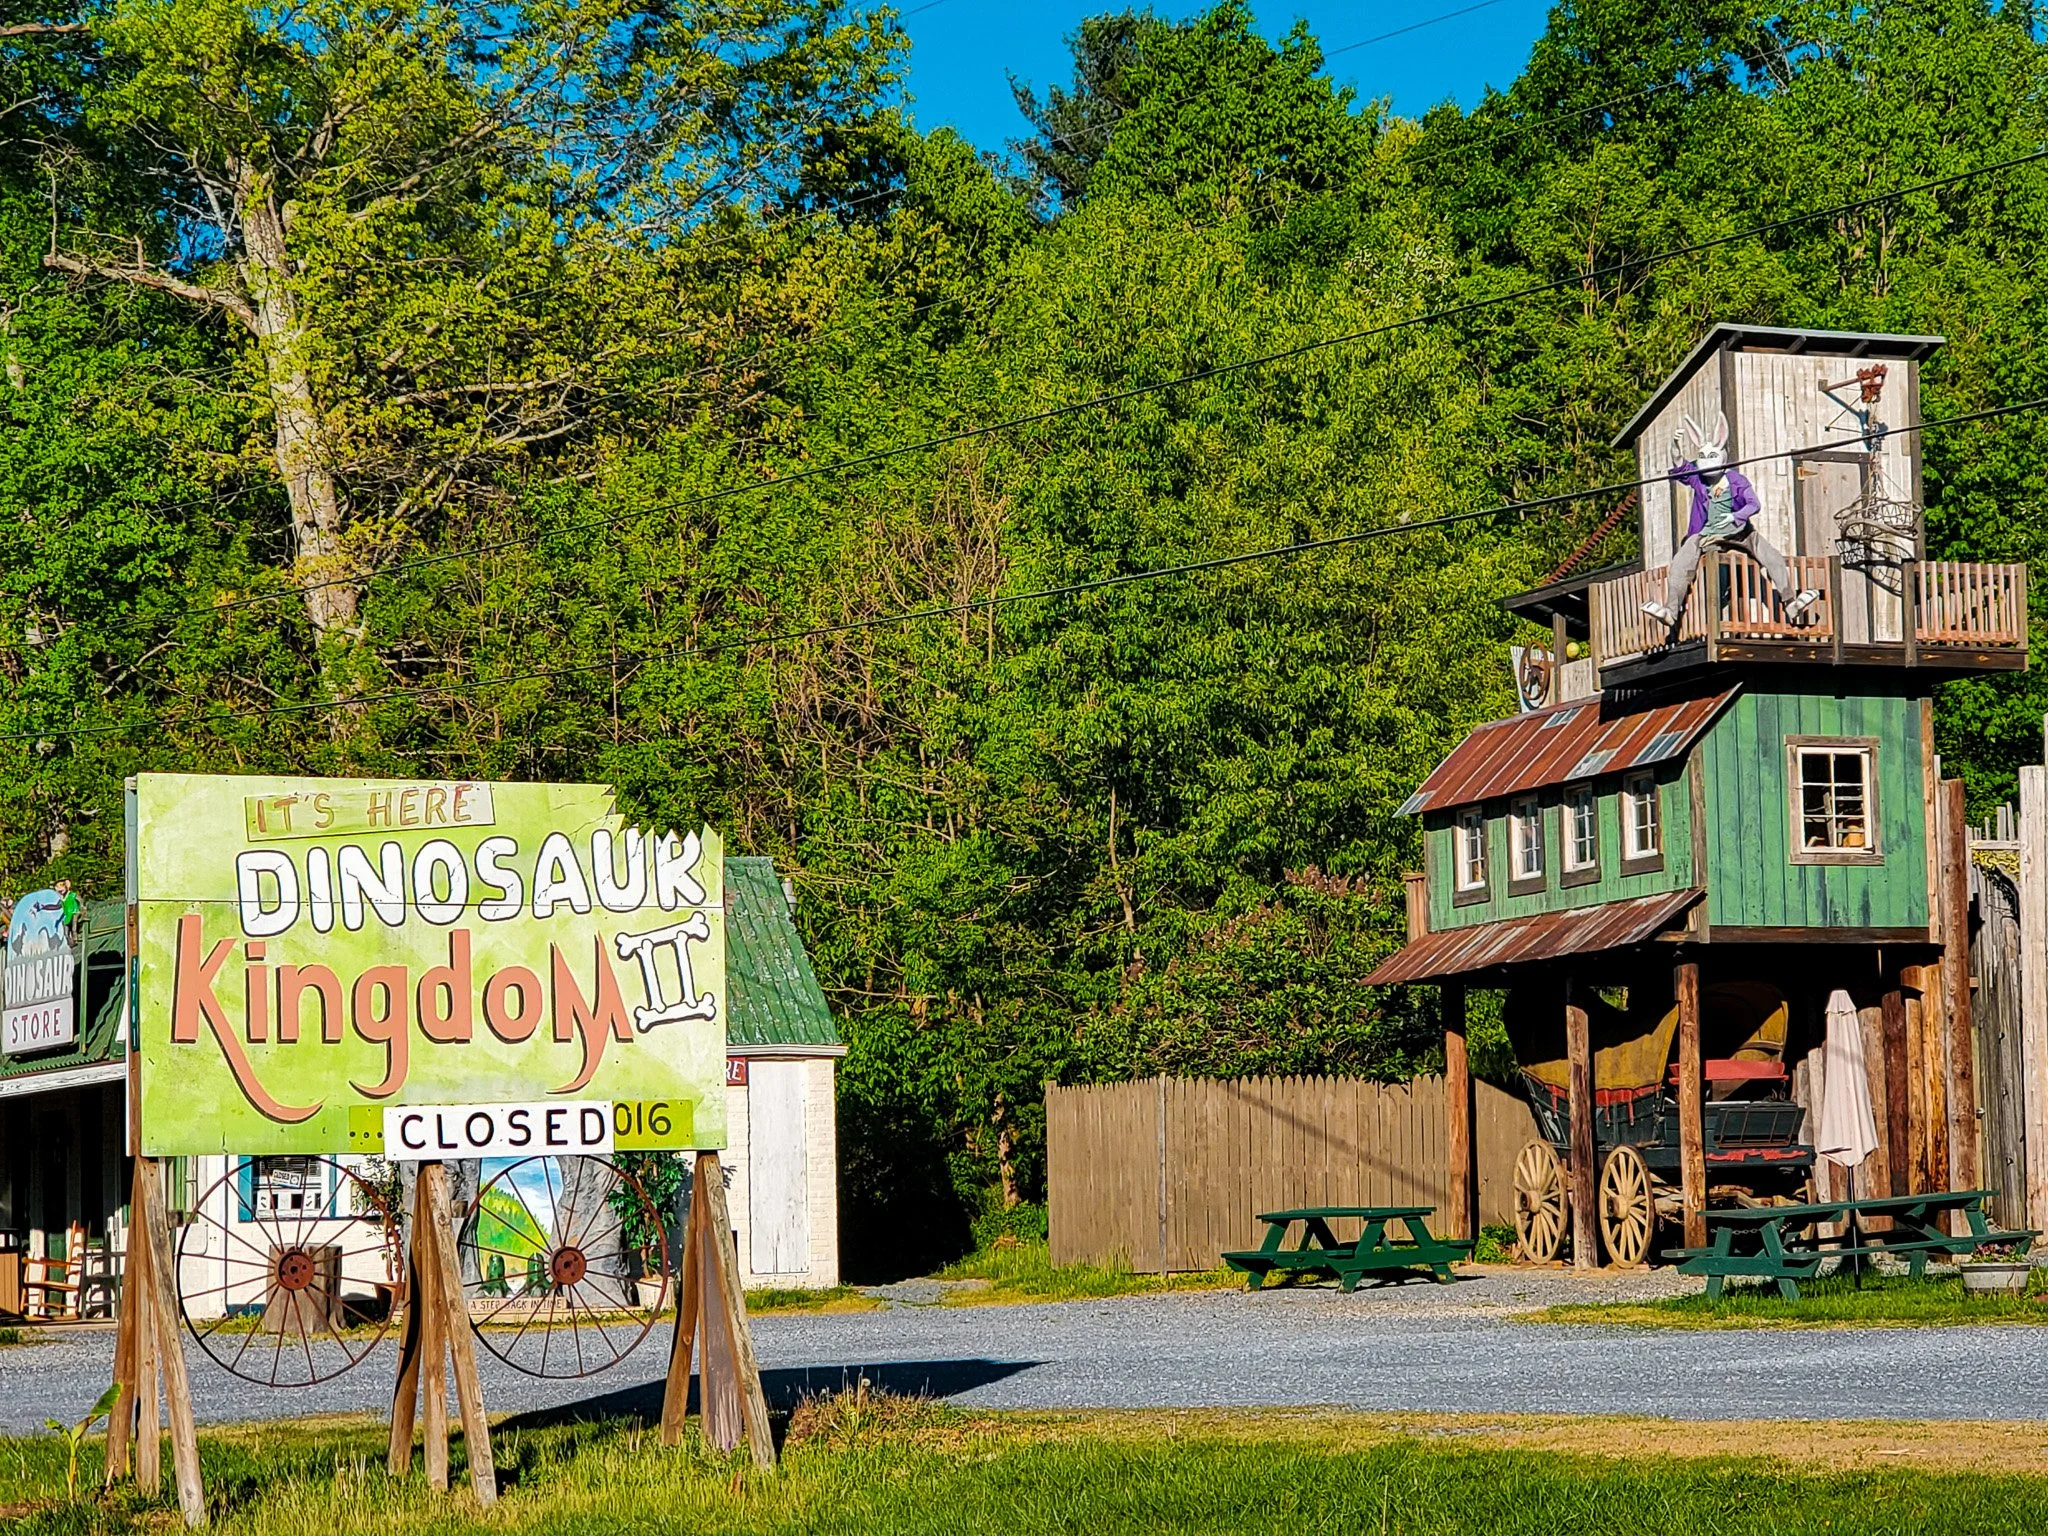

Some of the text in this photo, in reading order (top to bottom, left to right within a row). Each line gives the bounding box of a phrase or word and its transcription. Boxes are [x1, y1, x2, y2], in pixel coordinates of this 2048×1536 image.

[257, 784, 473, 833] IT'S HERE
[235, 824, 708, 937] DINOSAUR
[5, 954, 74, 1008] DINOSAUR
[12, 1008, 61, 1044] STORE
[400, 1106, 606, 1149] CLOSED
[470, 1301, 477, 1310] A
[480, 1300, 501, 1310] STEP
